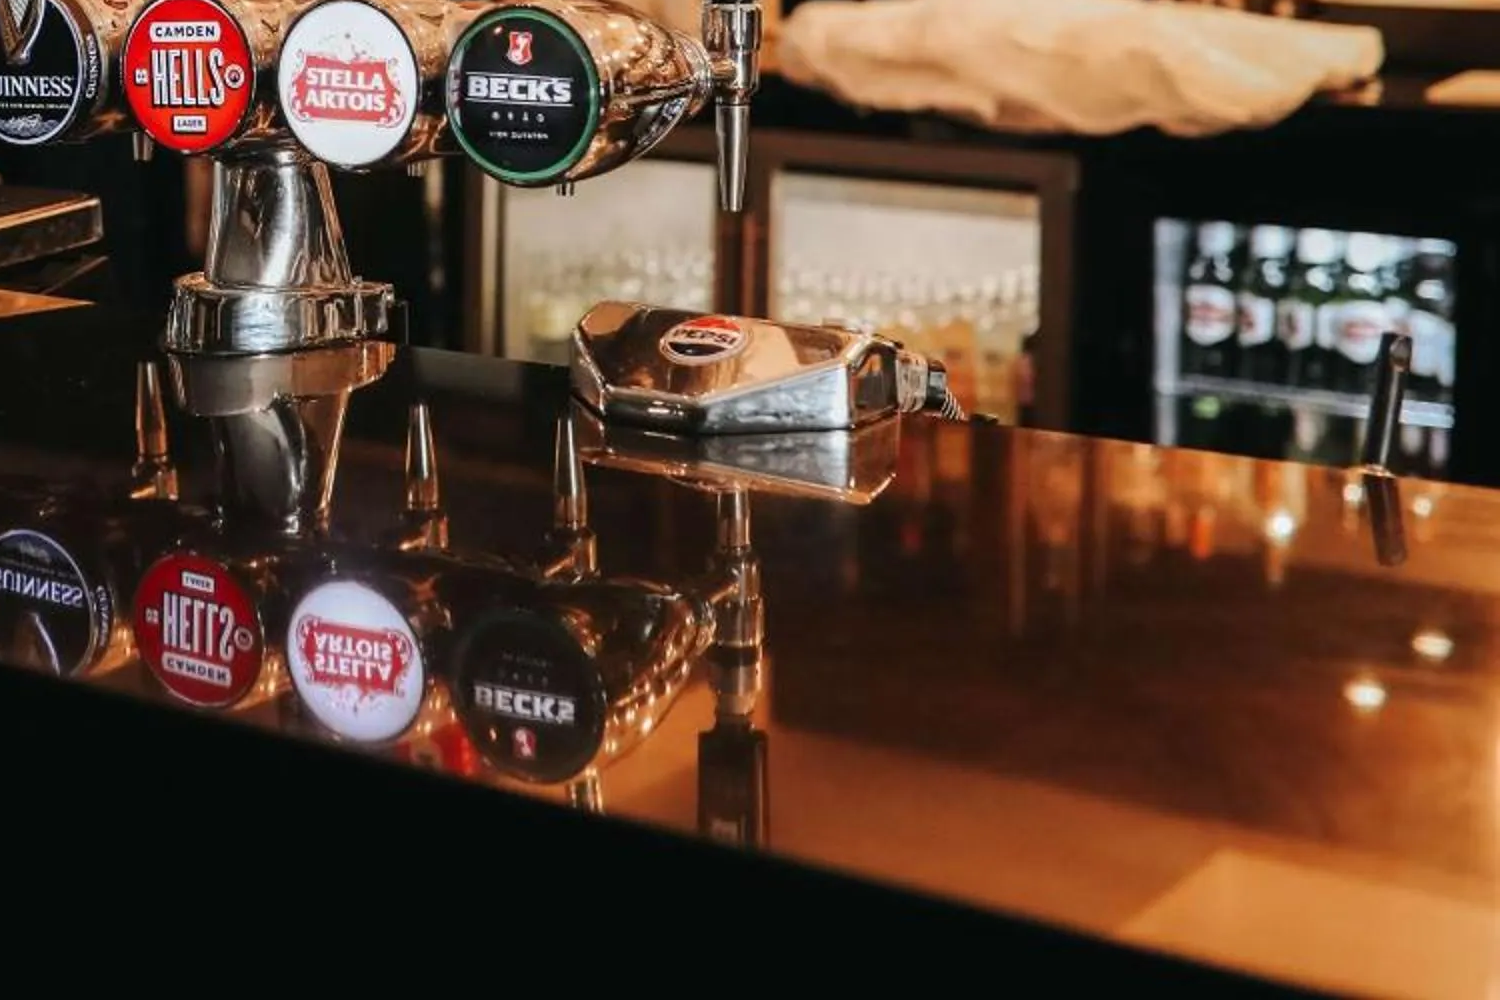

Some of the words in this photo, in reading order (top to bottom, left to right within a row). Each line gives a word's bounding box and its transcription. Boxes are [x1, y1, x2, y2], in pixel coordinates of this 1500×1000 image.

[155, 25, 215, 38] CAMDEN
[151, 48, 226, 106] HELLS
[306, 67, 386, 91] STELLA
[305, 89, 387, 112] ARTOIS
[467, 75, 572, 103] BECK'S
[673, 329, 738, 346] PEPSI
